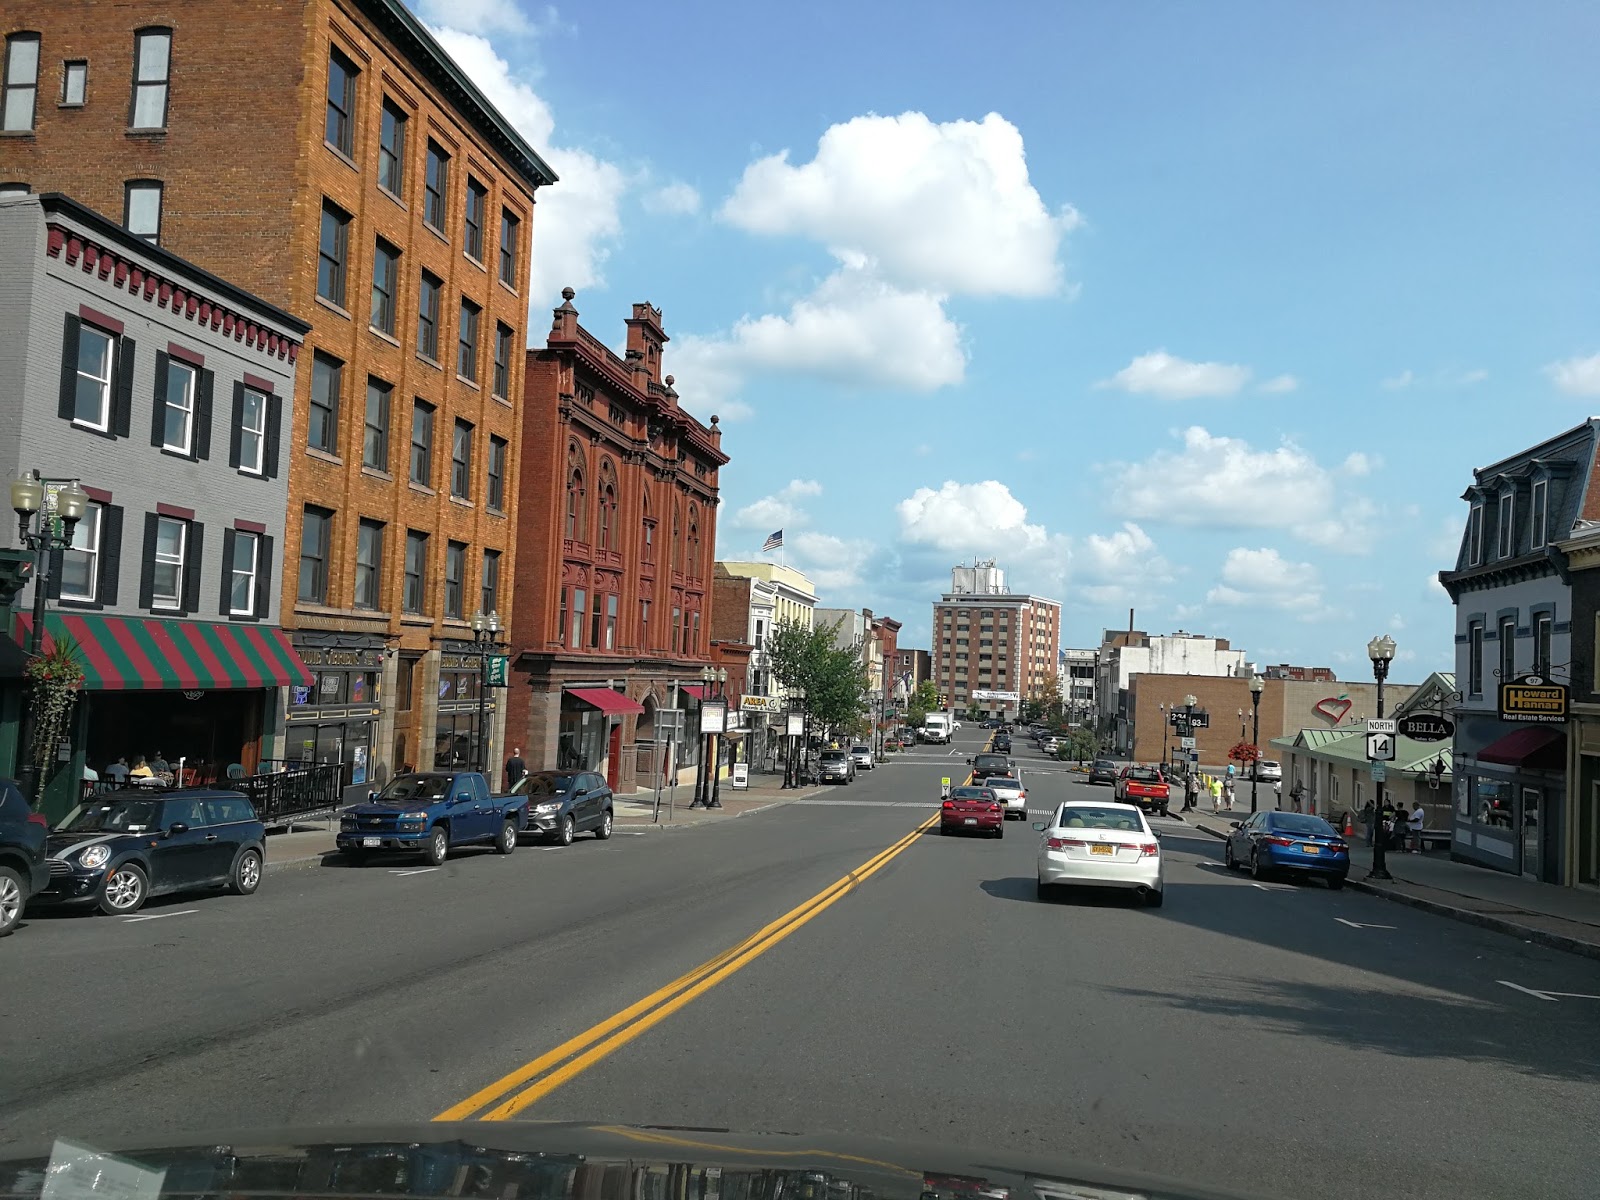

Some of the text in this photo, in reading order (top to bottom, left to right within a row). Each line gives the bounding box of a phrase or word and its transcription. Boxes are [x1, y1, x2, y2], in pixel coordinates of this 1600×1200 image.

[743, 697, 767, 706] AREA
[1192, 719, 1201, 727] 93
[1369, 722, 1393, 730] NORTH
[1407, 721, 1447, 734] BELLA
[1373, 739, 1389, 754] 14
